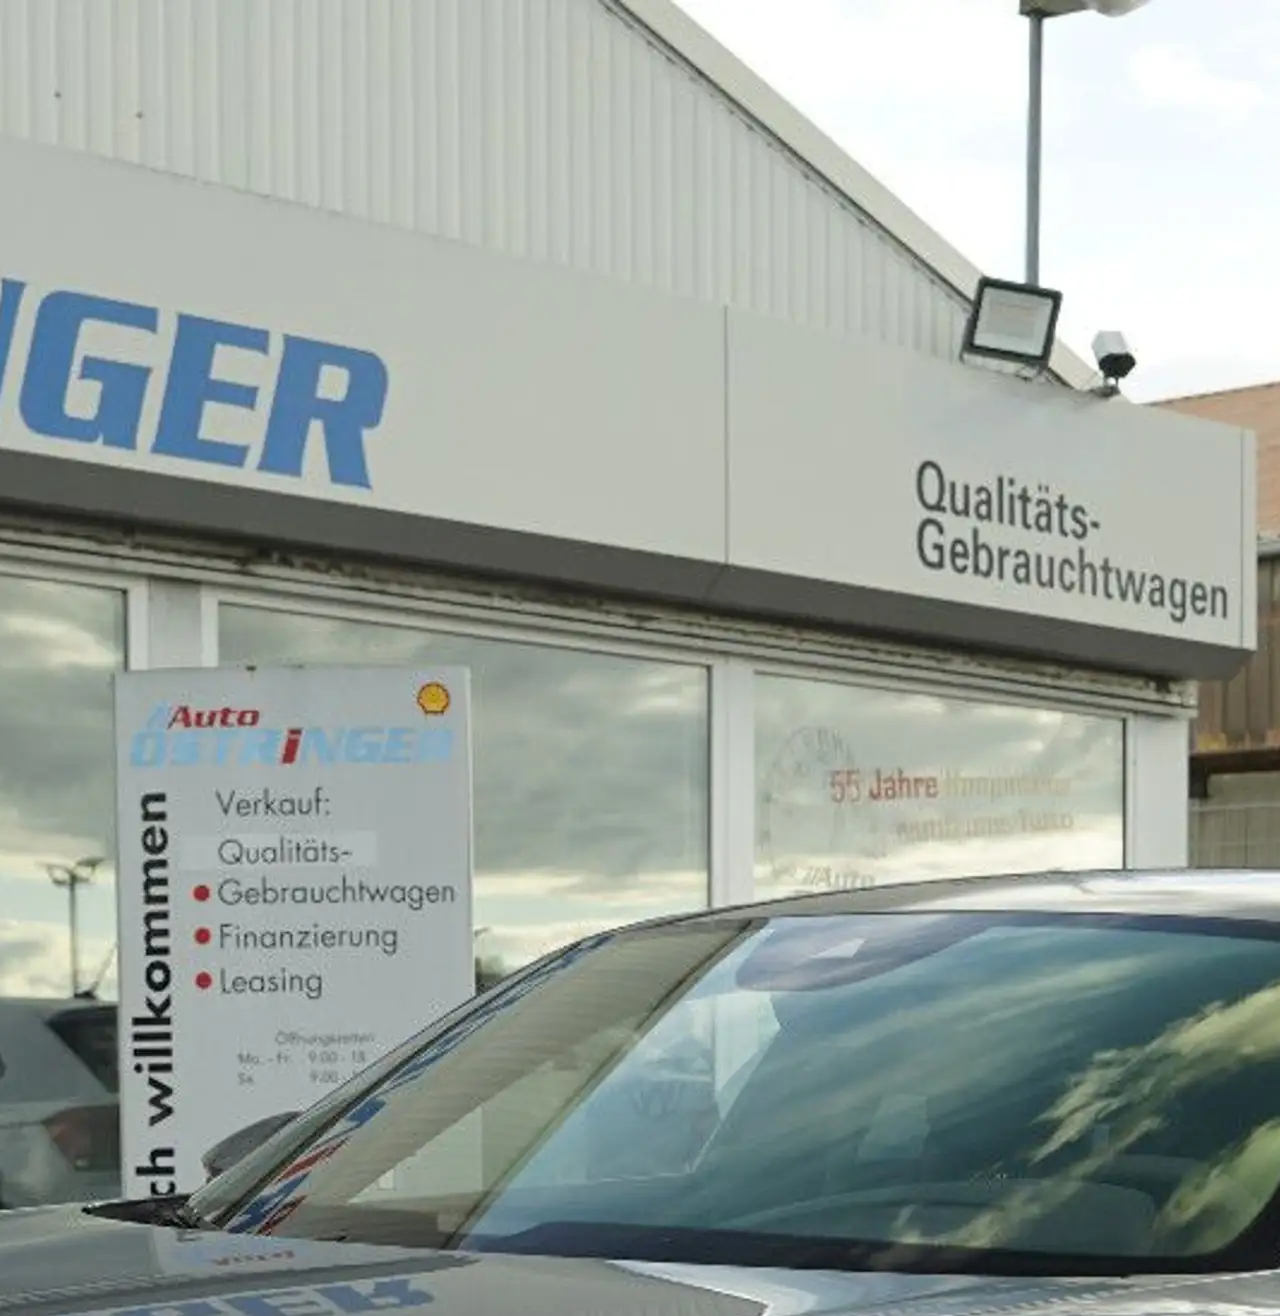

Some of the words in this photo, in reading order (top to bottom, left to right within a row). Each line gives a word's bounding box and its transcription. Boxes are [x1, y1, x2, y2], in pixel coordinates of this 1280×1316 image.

[916, 460, 1100, 540] Qualitäts-
[916, 518, 1228, 623] Gebrauchtwagen
[168, 706, 259, 729] Auto
[216, 787, 331, 817] Verkauf:
[829, 769, 861, 804] 55
[869, 767, 939, 802] Jahre
[218, 837, 353, 865] Qualitäts-
[218, 875, 455, 910] Gebrauchtwagen
[219, 922, 398, 954] Finanzierung
[132, 792, 175, 1127] willkommen
[221, 967, 323, 998] Leasing
